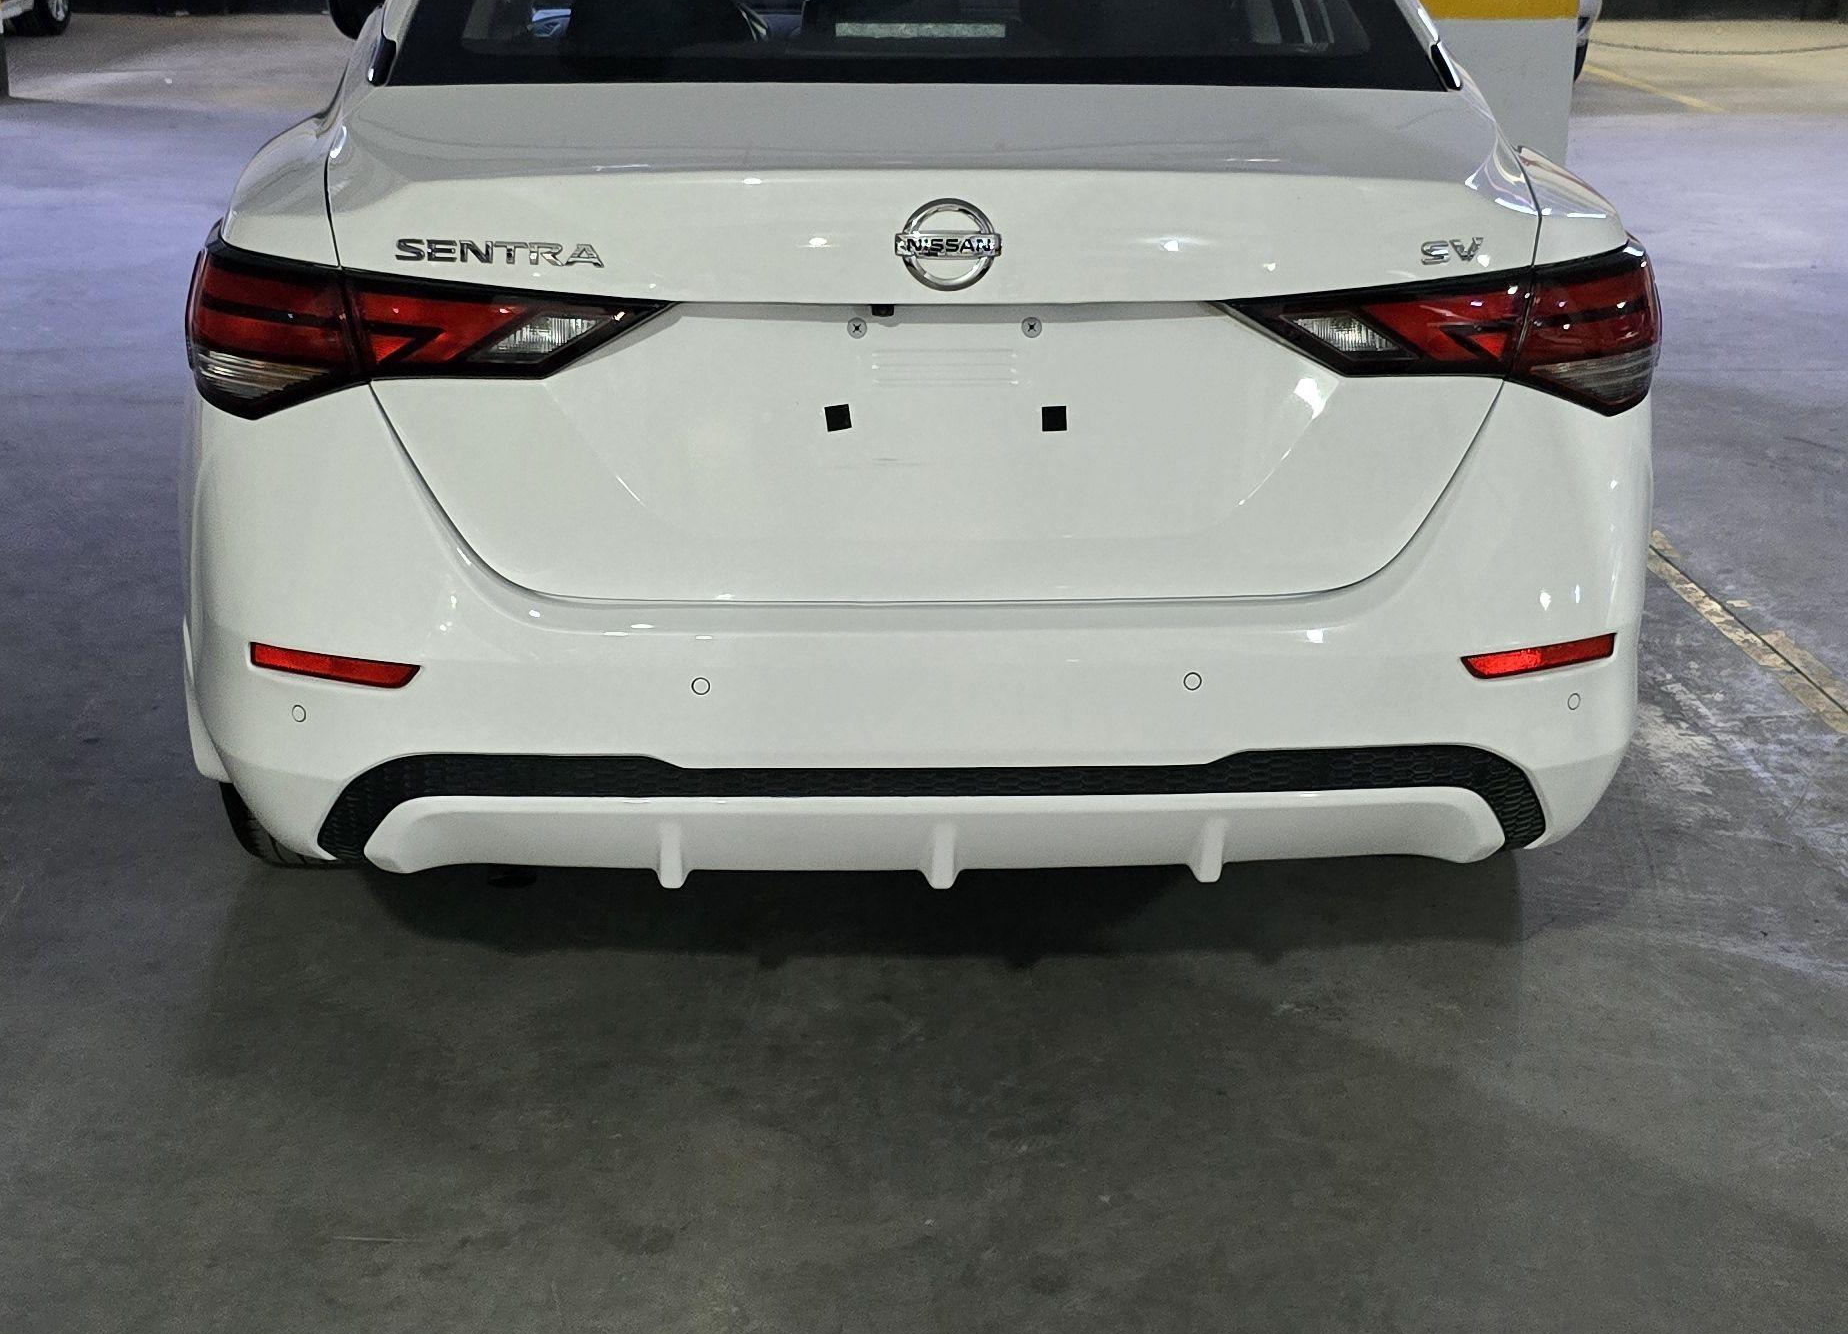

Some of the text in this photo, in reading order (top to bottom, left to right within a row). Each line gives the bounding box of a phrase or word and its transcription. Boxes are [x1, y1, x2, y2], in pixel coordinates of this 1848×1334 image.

[395, 238, 604, 268] SENTRA
[905, 238, 991, 253] NISSAN
[1420, 236, 1484, 265] SV
